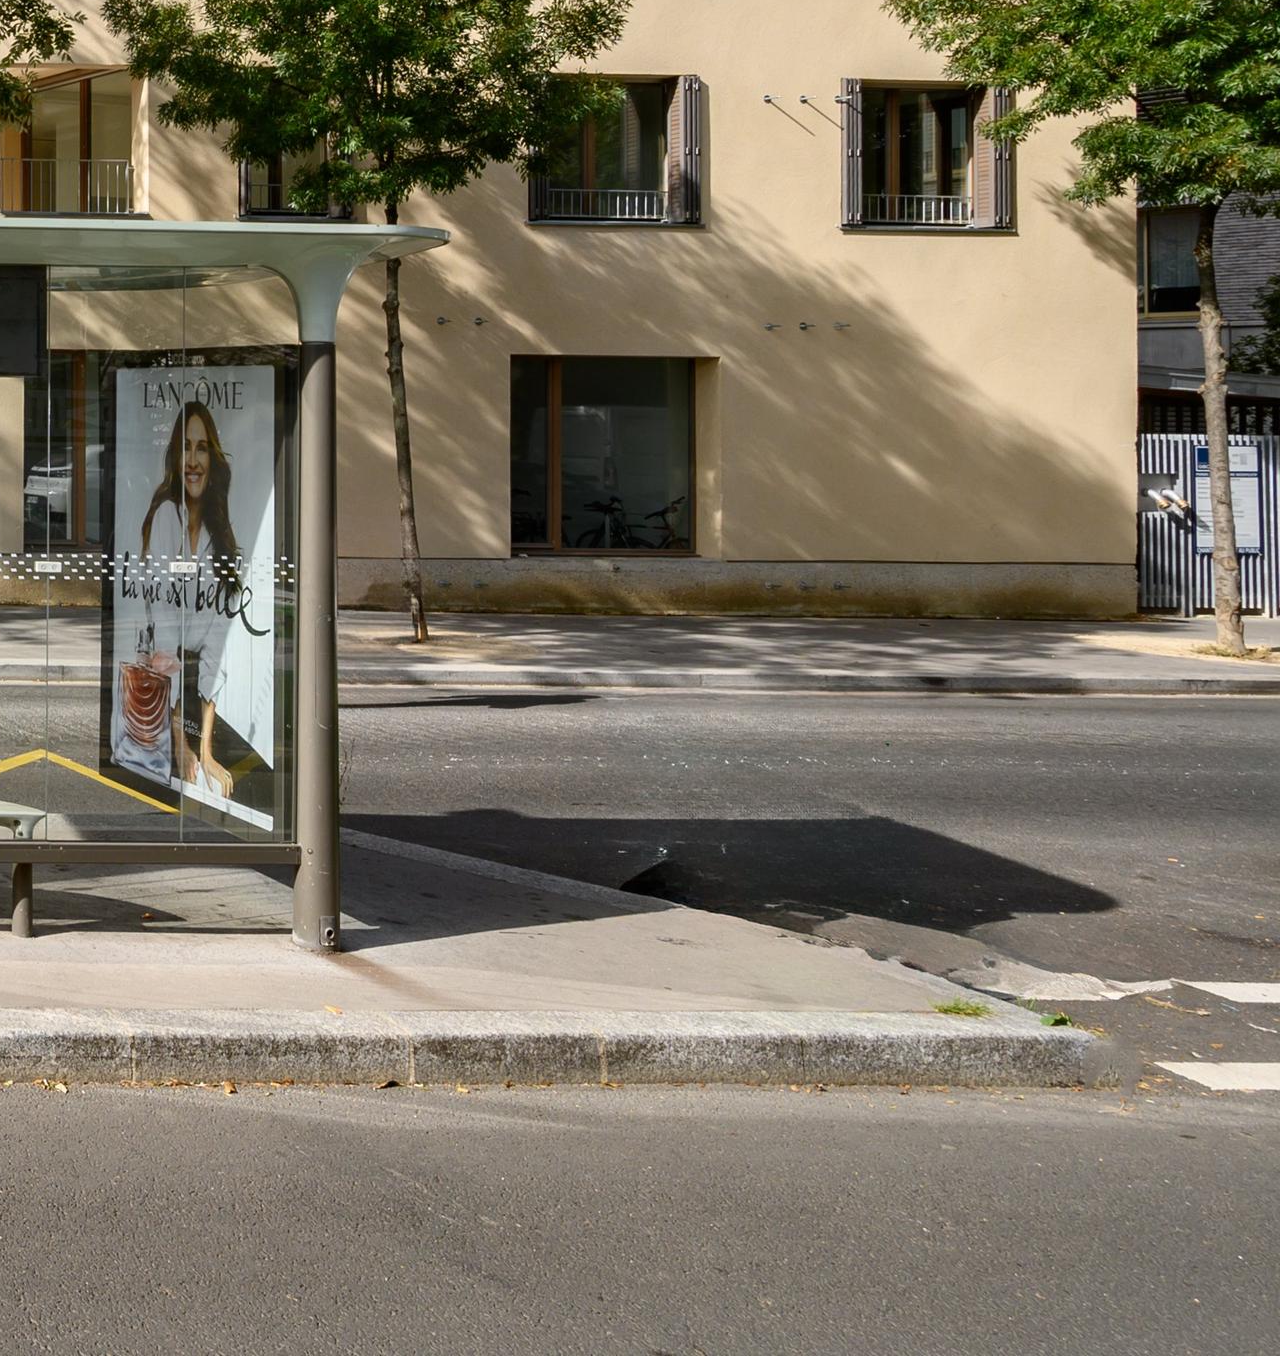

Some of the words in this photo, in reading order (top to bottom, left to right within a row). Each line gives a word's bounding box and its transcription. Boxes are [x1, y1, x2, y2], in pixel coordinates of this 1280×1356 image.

[144, 376, 244, 410] LANCÔME
[142, 575, 161, 603] vie
[167, 573, 193, 609] est
[196, 558, 271, 636] belle
